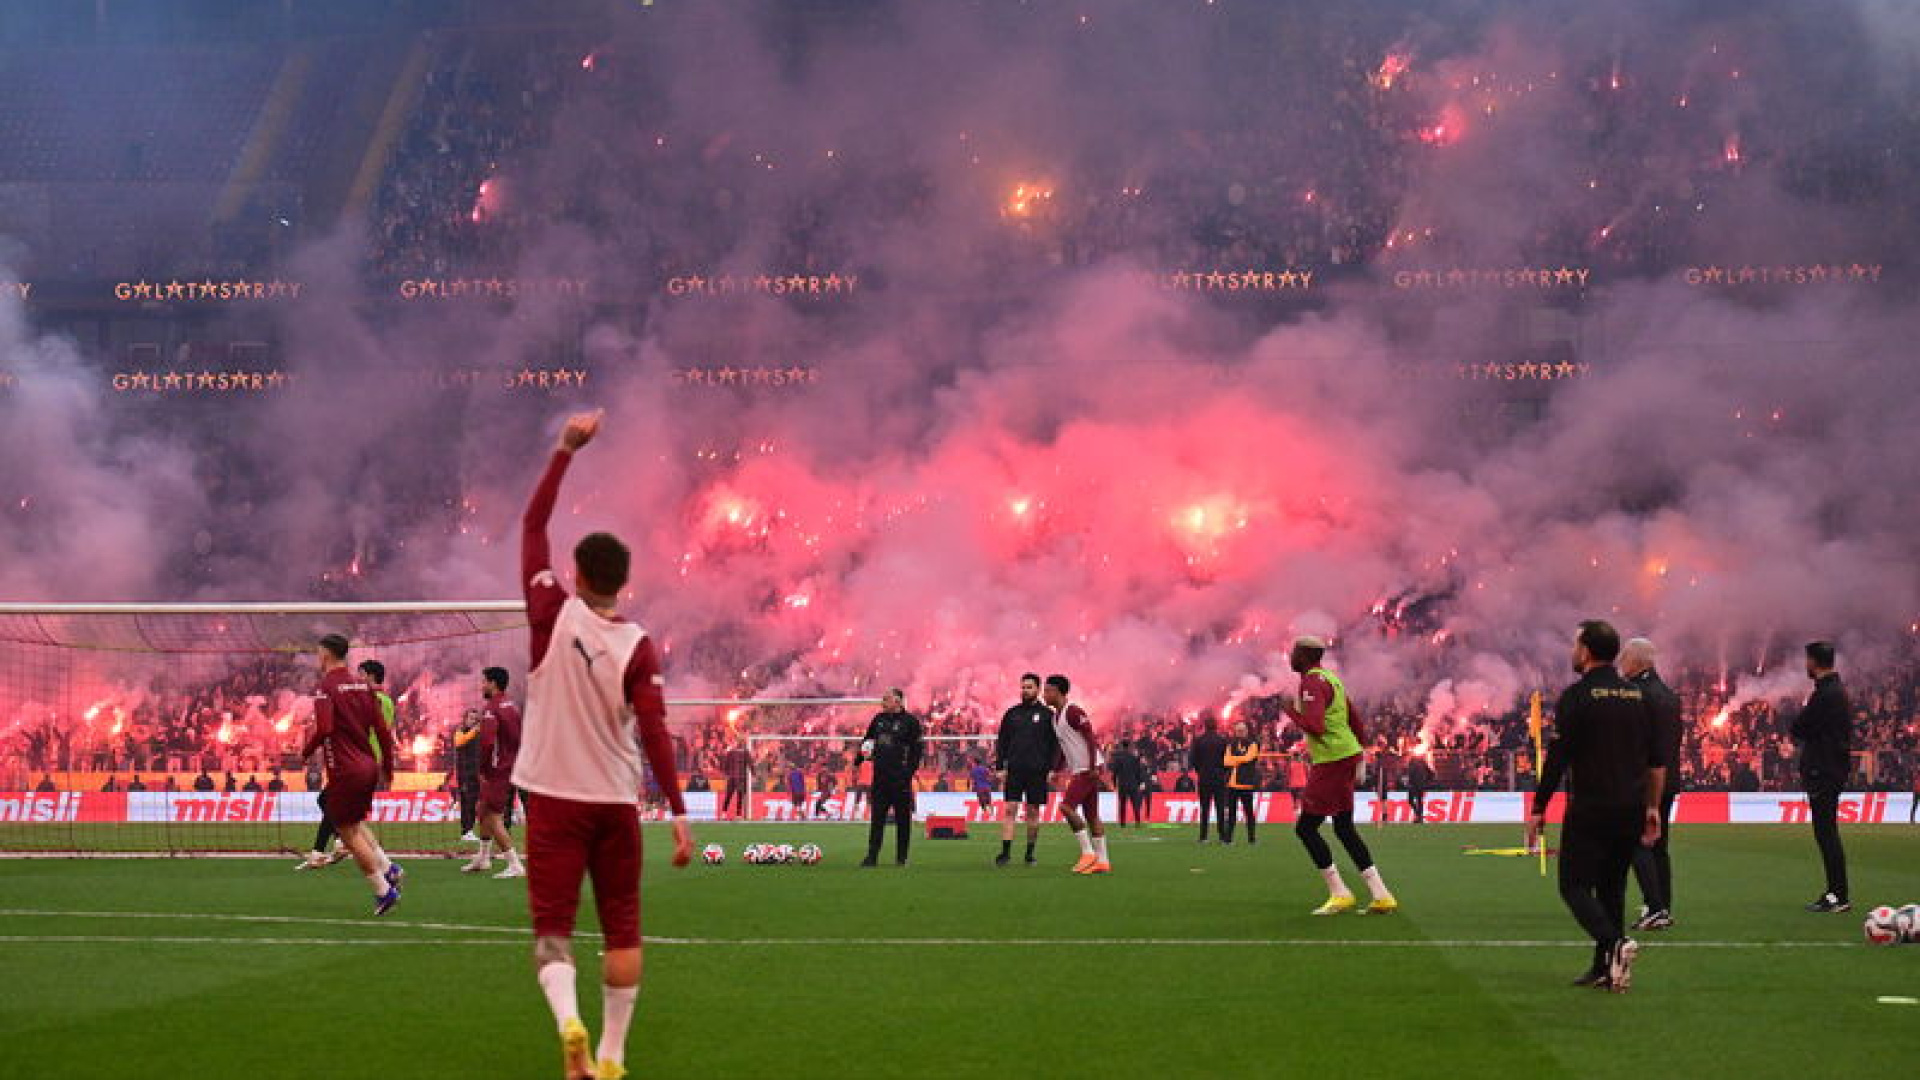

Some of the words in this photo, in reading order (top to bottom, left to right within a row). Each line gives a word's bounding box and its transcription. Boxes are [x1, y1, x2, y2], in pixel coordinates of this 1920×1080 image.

[114, 278, 302, 301] GALATASARAY
[401, 277, 588, 300] GALATASAY
[1159, 269, 1314, 291] LATASARAY
[112, 369, 300, 391] GALATASARA
[173, 791, 279, 822] misli
[371, 791, 453, 822] mis
[1367, 791, 1476, 822] msli
[1778, 791, 1889, 822] msli
